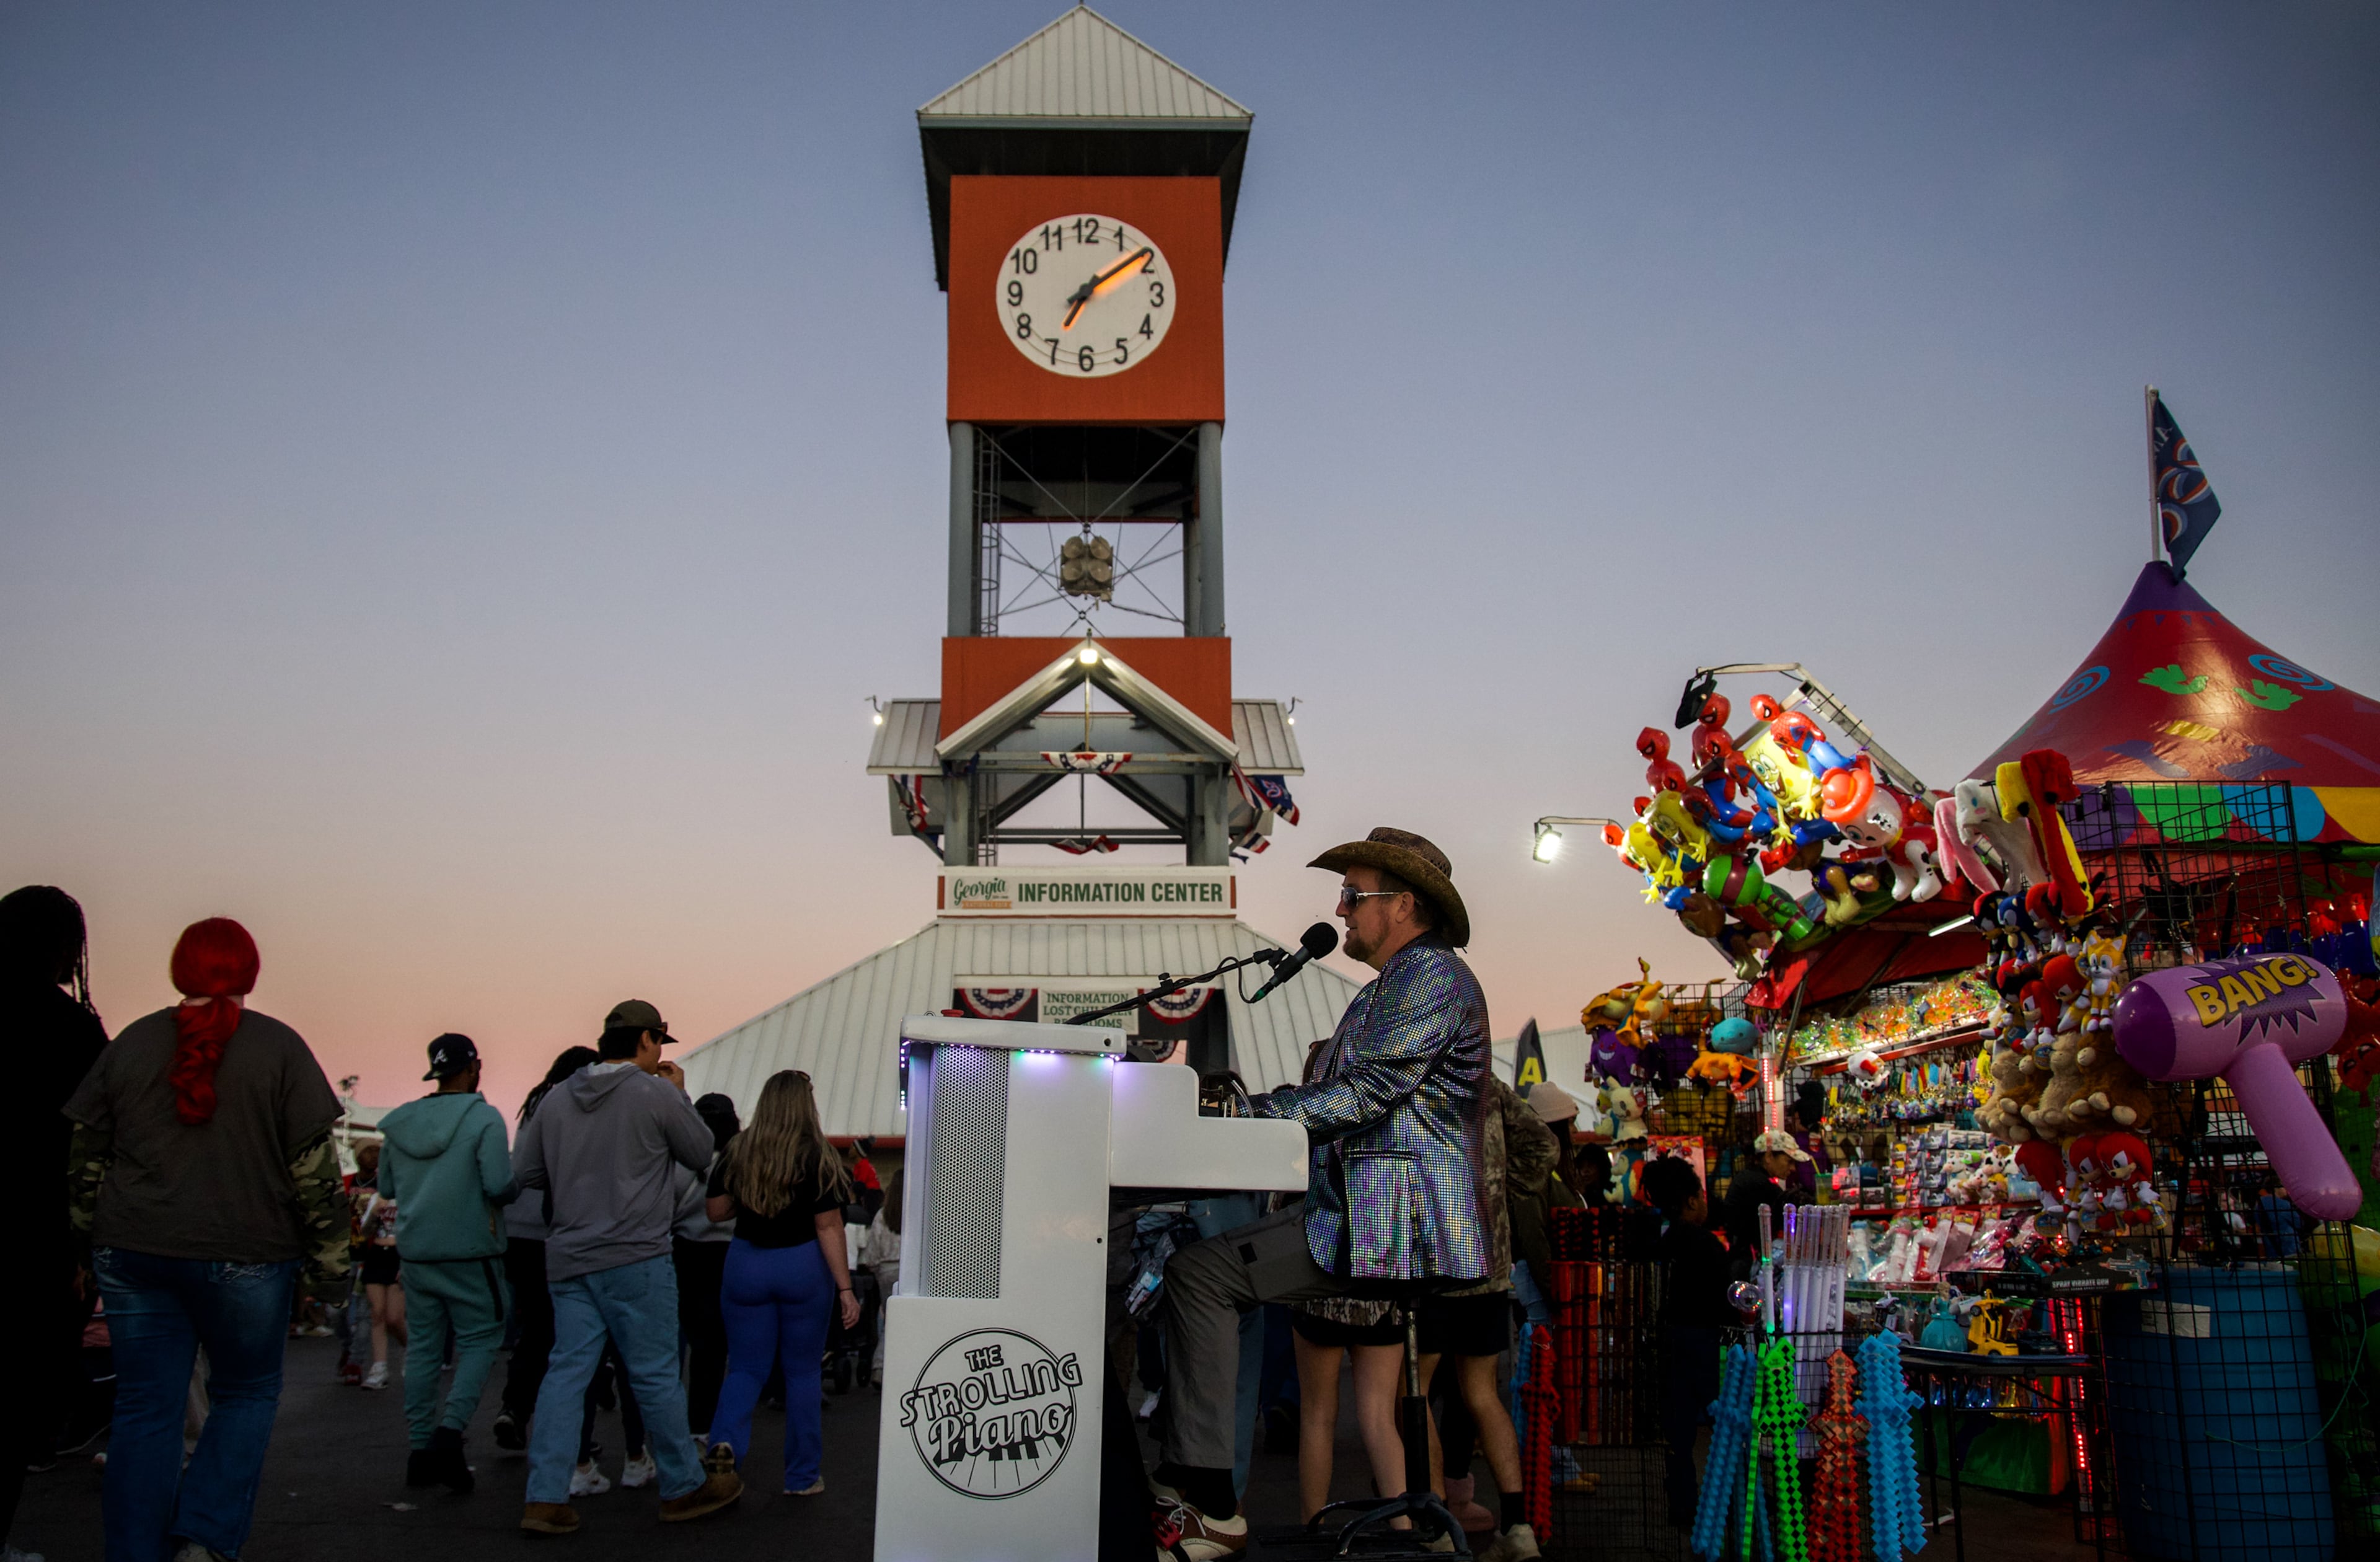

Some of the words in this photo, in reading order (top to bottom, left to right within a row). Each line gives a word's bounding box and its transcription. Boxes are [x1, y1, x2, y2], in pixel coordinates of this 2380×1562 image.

[1040, 224, 1062, 250] 11
[1072, 218, 1099, 244] 12
[1114, 226, 1123, 252] 1
[1010, 247, 1038, 274] 10
[1141, 246, 1154, 273] 2
[1008, 280, 1023, 306] 9
[1150, 281, 1164, 307] 3
[1017, 312, 1031, 339] 8
[1139, 313, 1153, 340] 4
[1044, 338, 1059, 365] 7
[1078, 345, 1094, 371] 6
[1114, 337, 1128, 364] 5
[954, 877, 1005, 906] Georgia
[1018, 883, 1145, 902] INFORMATION
[1151, 882, 1223, 902] CENTER
[1047, 993, 1129, 1003] INFORMATION
[2186, 955, 2319, 1028] BANG!
[1044, 1005, 1072, 1015] LOST
[433, 1048, 449, 1064] A
[964, 1344, 1004, 1372] THE
[900, 1352, 1082, 1427] STROLLING
[928, 1402, 1073, 1463] Piano
